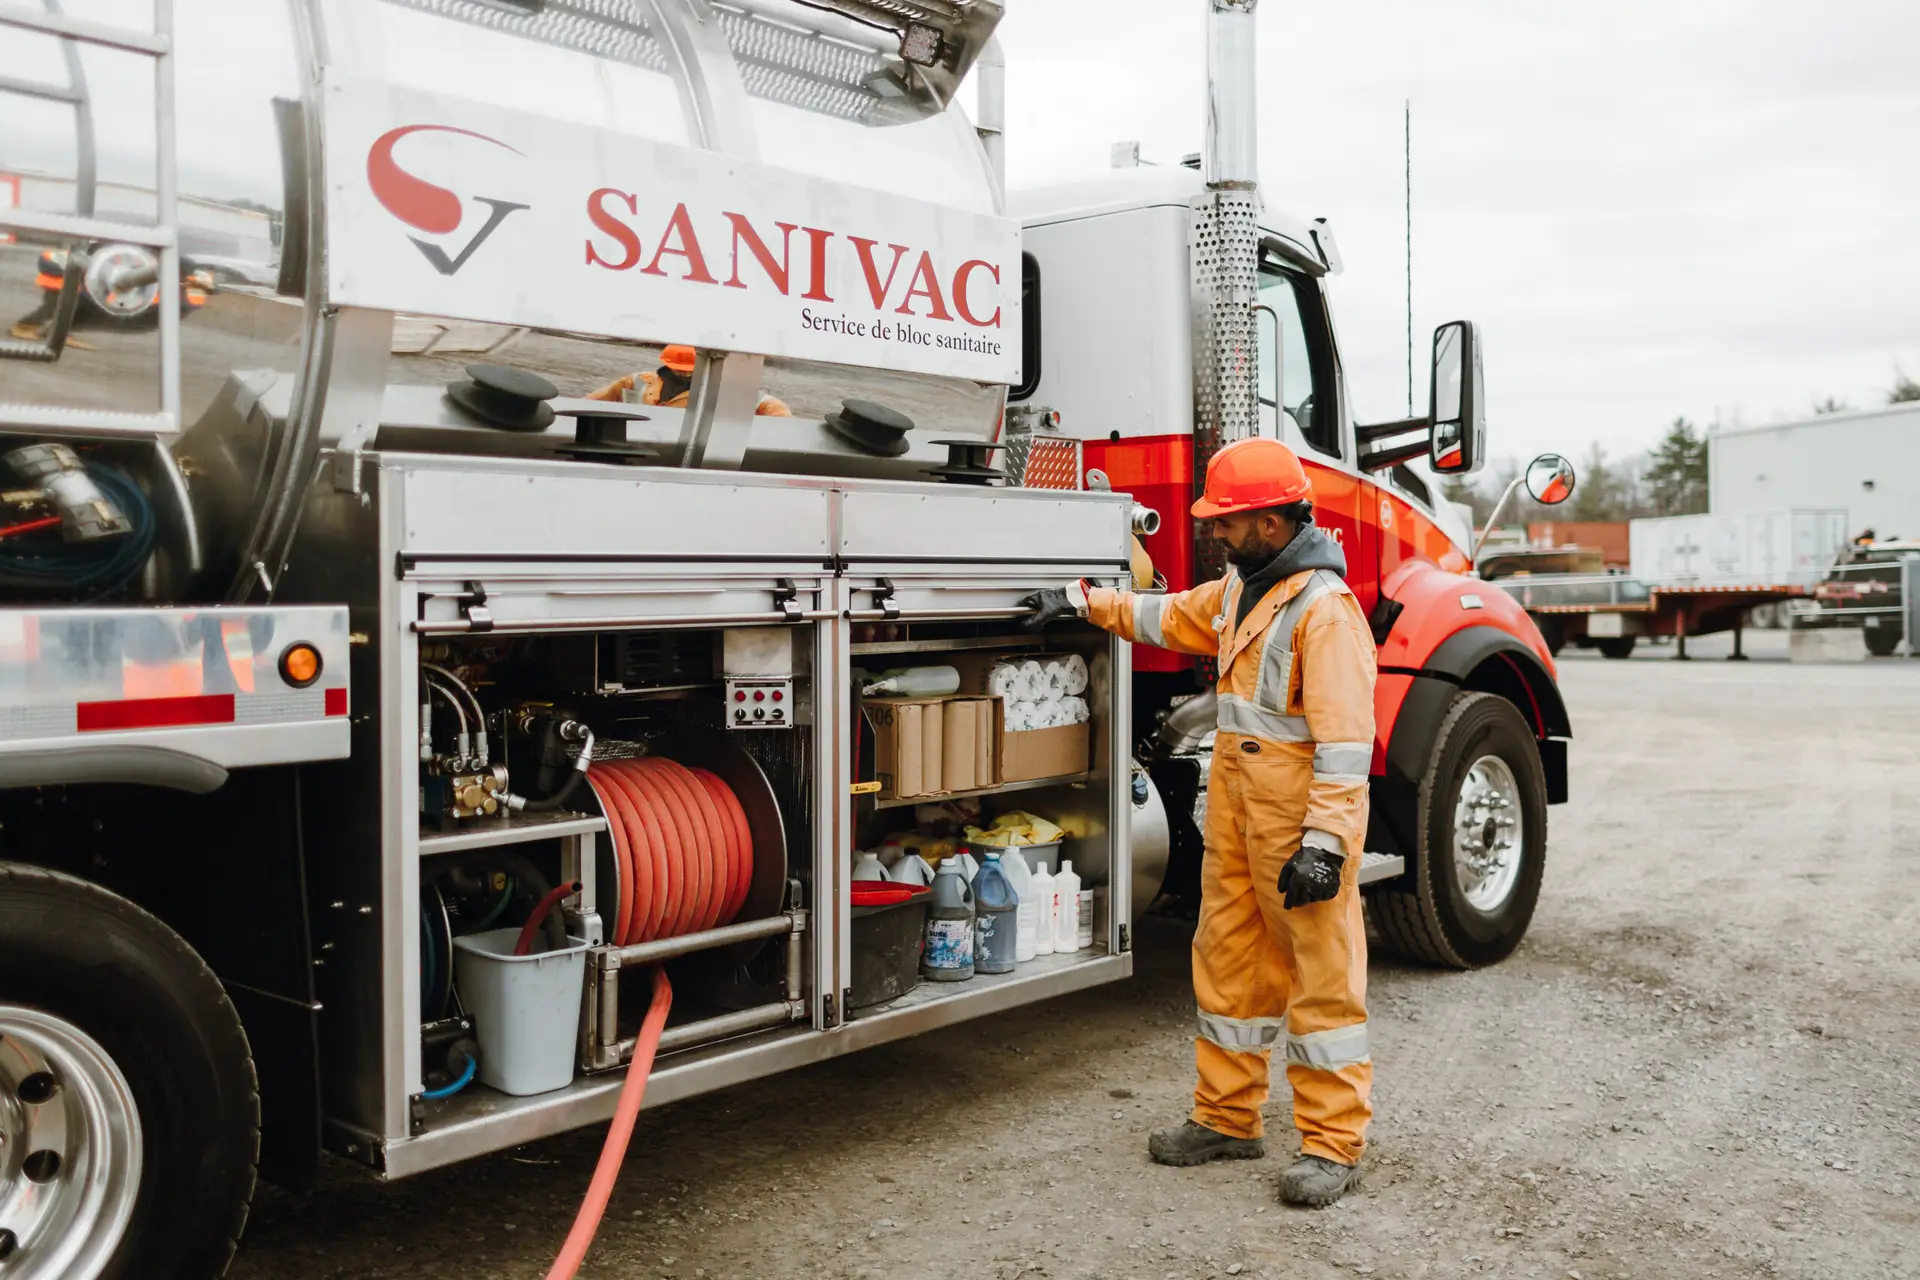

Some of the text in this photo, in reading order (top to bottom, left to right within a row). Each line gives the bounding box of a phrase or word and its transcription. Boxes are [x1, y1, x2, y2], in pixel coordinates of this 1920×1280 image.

[585, 187, 1001, 329] SANIVAC
[801, 308, 1001, 356] Service de bloc sanitaire
